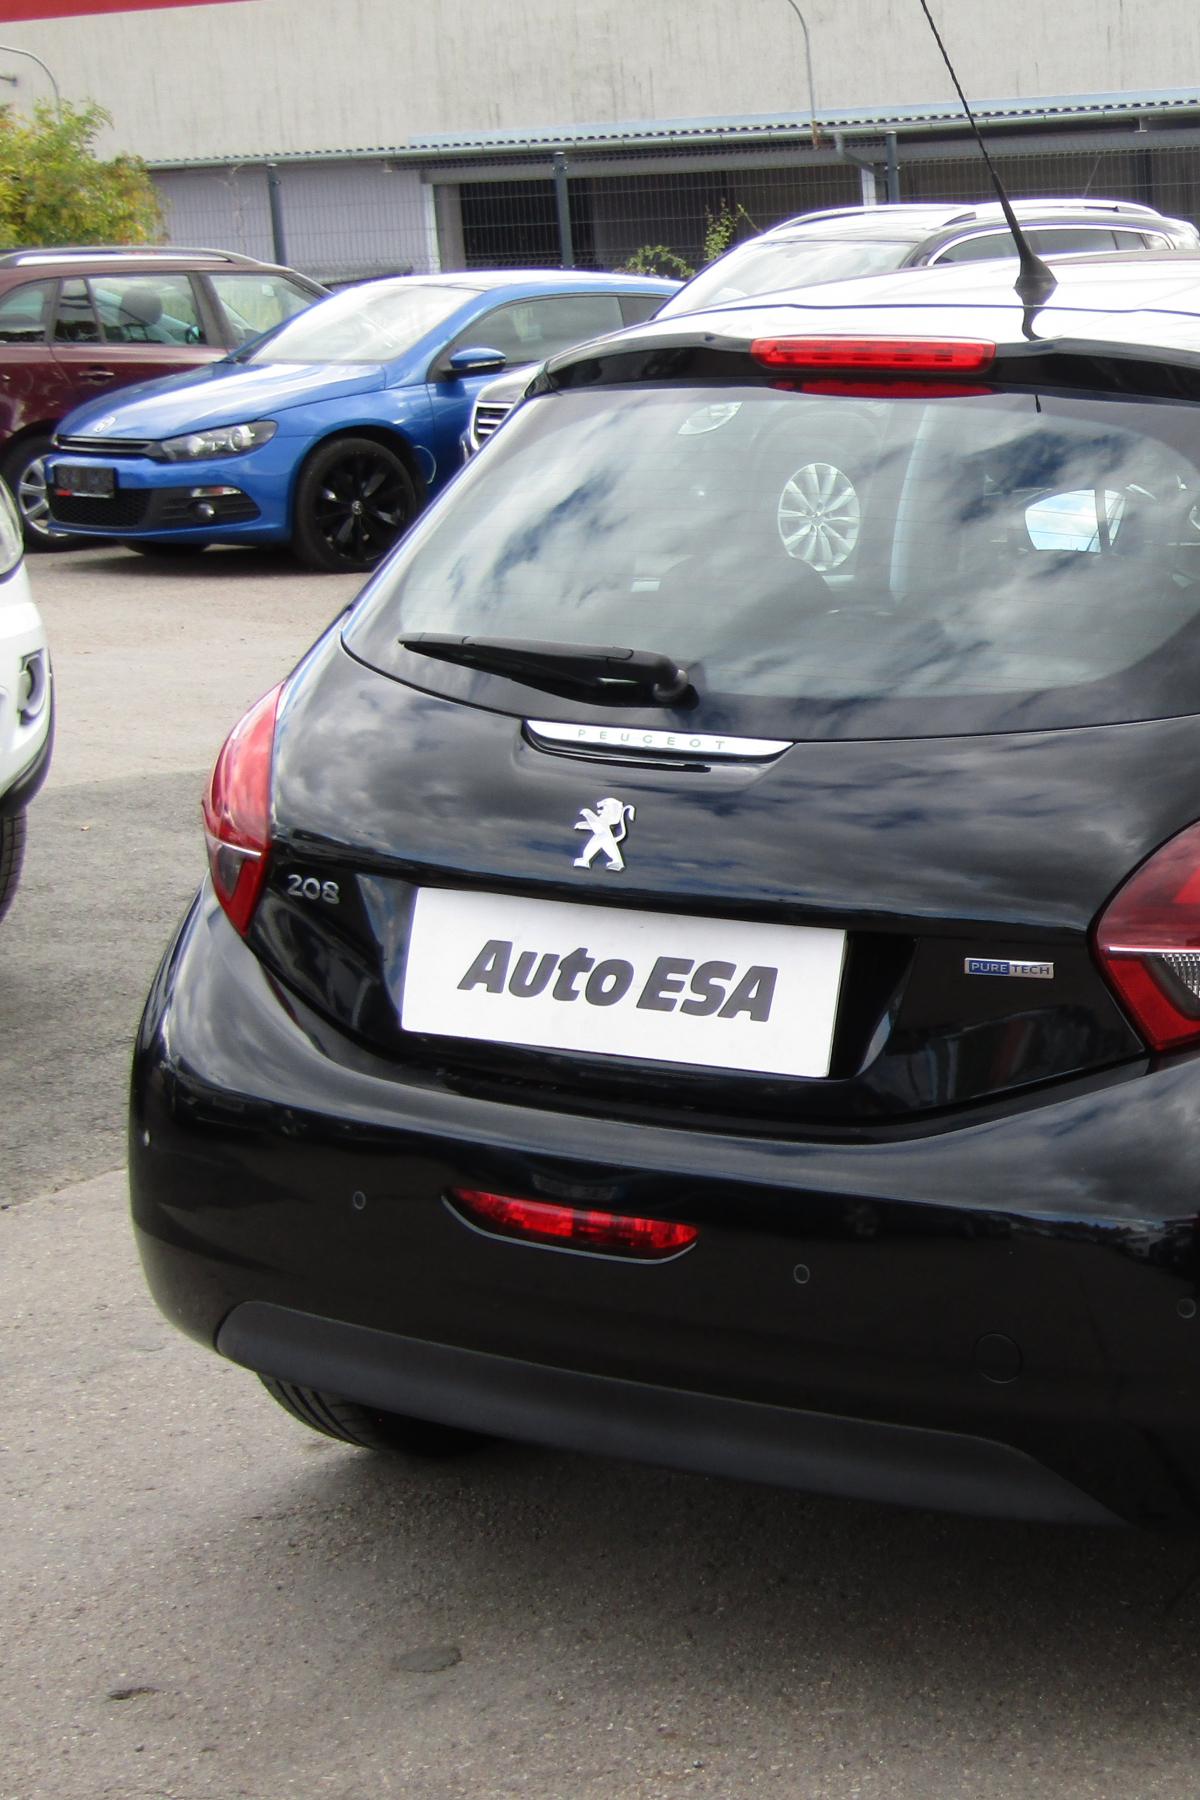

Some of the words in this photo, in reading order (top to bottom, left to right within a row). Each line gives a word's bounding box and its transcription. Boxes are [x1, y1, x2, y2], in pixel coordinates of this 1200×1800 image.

[577, 728, 725, 750] PEUGEOT
[286, 873, 340, 905] 208
[457, 938, 634, 1006] Auto
[636, 955, 779, 1023] ESA
